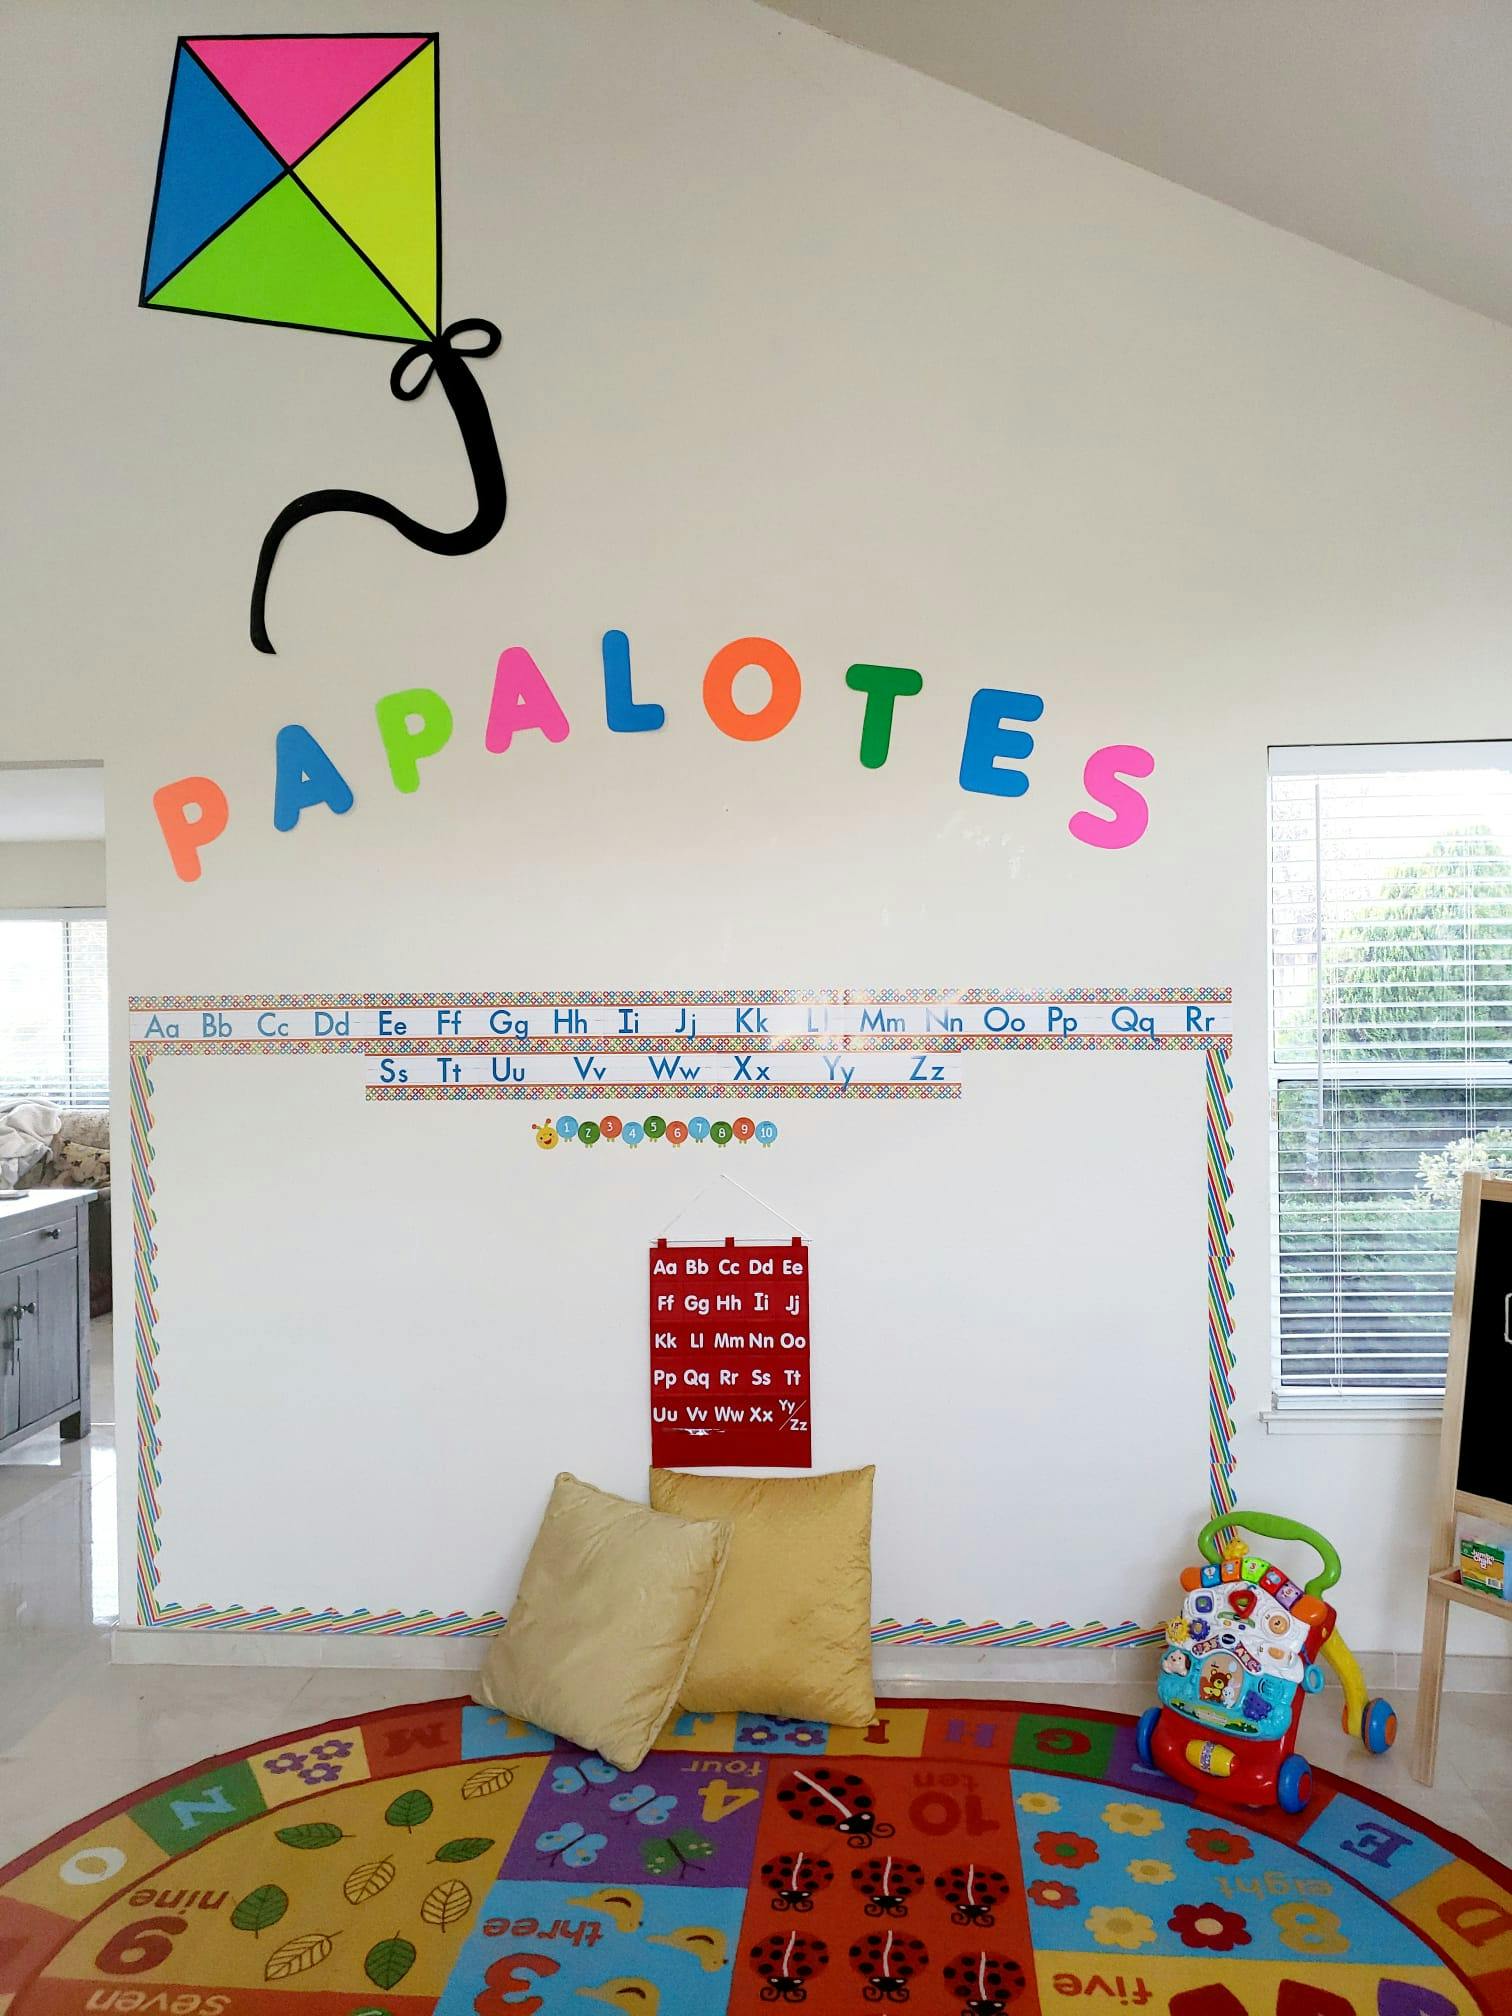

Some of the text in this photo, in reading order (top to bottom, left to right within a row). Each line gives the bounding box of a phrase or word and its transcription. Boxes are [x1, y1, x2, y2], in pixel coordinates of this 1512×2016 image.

[153, 630, 1155, 882] PAPALOTES
[145, 1014, 180, 1039] Aa
[201, 1012, 233, 1038] Bb
[256, 1011, 289, 1037] Cc
[313, 1011, 350, 1037] Dd
[378, 1010, 407, 1036] Ee
[437, 1009, 462, 1035] Ff
[489, 1009, 529, 1041] Gg
[554, 1008, 588, 1034] Hh
[618, 1008, 640, 1034] Ii
[674, 1007, 697, 1041] Jj
[736, 1007, 769, 1033] Kk
[859, 1007, 906, 1033] Mm
[925, 1007, 964, 1033] Nn
[983, 1006, 1026, 1033] Oo
[1047, 1006, 1079, 1038] Pp
[1110, 1006, 1159, 1041] Qq
[1186, 1005, 1217, 1032] Rr
[378, 1055, 946, 1091] Ss Tt Uu Vv Ww Xx Yy Zz
[653, 1259, 803, 1275] Aa Bb Cc Dd Ee
[657, 1293, 800, 1315] Ff Gg Hh Ii Jj
[655, 1333, 806, 1349] Kk Ll Mm Nn Oo
[653, 1370, 801, 1389] Pp Qq Rr Ss Tt
[653, 1400, 808, 1431] Uu Vv Ww Xx Yy Zz
[383, 1722, 448, 1757] M
[944, 1719, 997, 1747] H
[681, 1760, 763, 1777] four
[913, 1771, 979, 1793] ten
[698, 1779, 759, 1823] 4
[909, 1791, 1000, 1837] 10
[1340, 1822, 1414, 1869] E
[59, 1846, 128, 1886] O
[1216, 1871, 1334, 1900] eight
[129, 1889, 230, 1915] nine
[483, 1917, 604, 1948] three
[1271, 1901, 1351, 1955] 8
[1437, 1896, 1512, 1949] D
[474, 1952, 561, 2016] 3
[1053, 1973, 1153, 2006] five
[84, 1989, 232, 2016] seven
